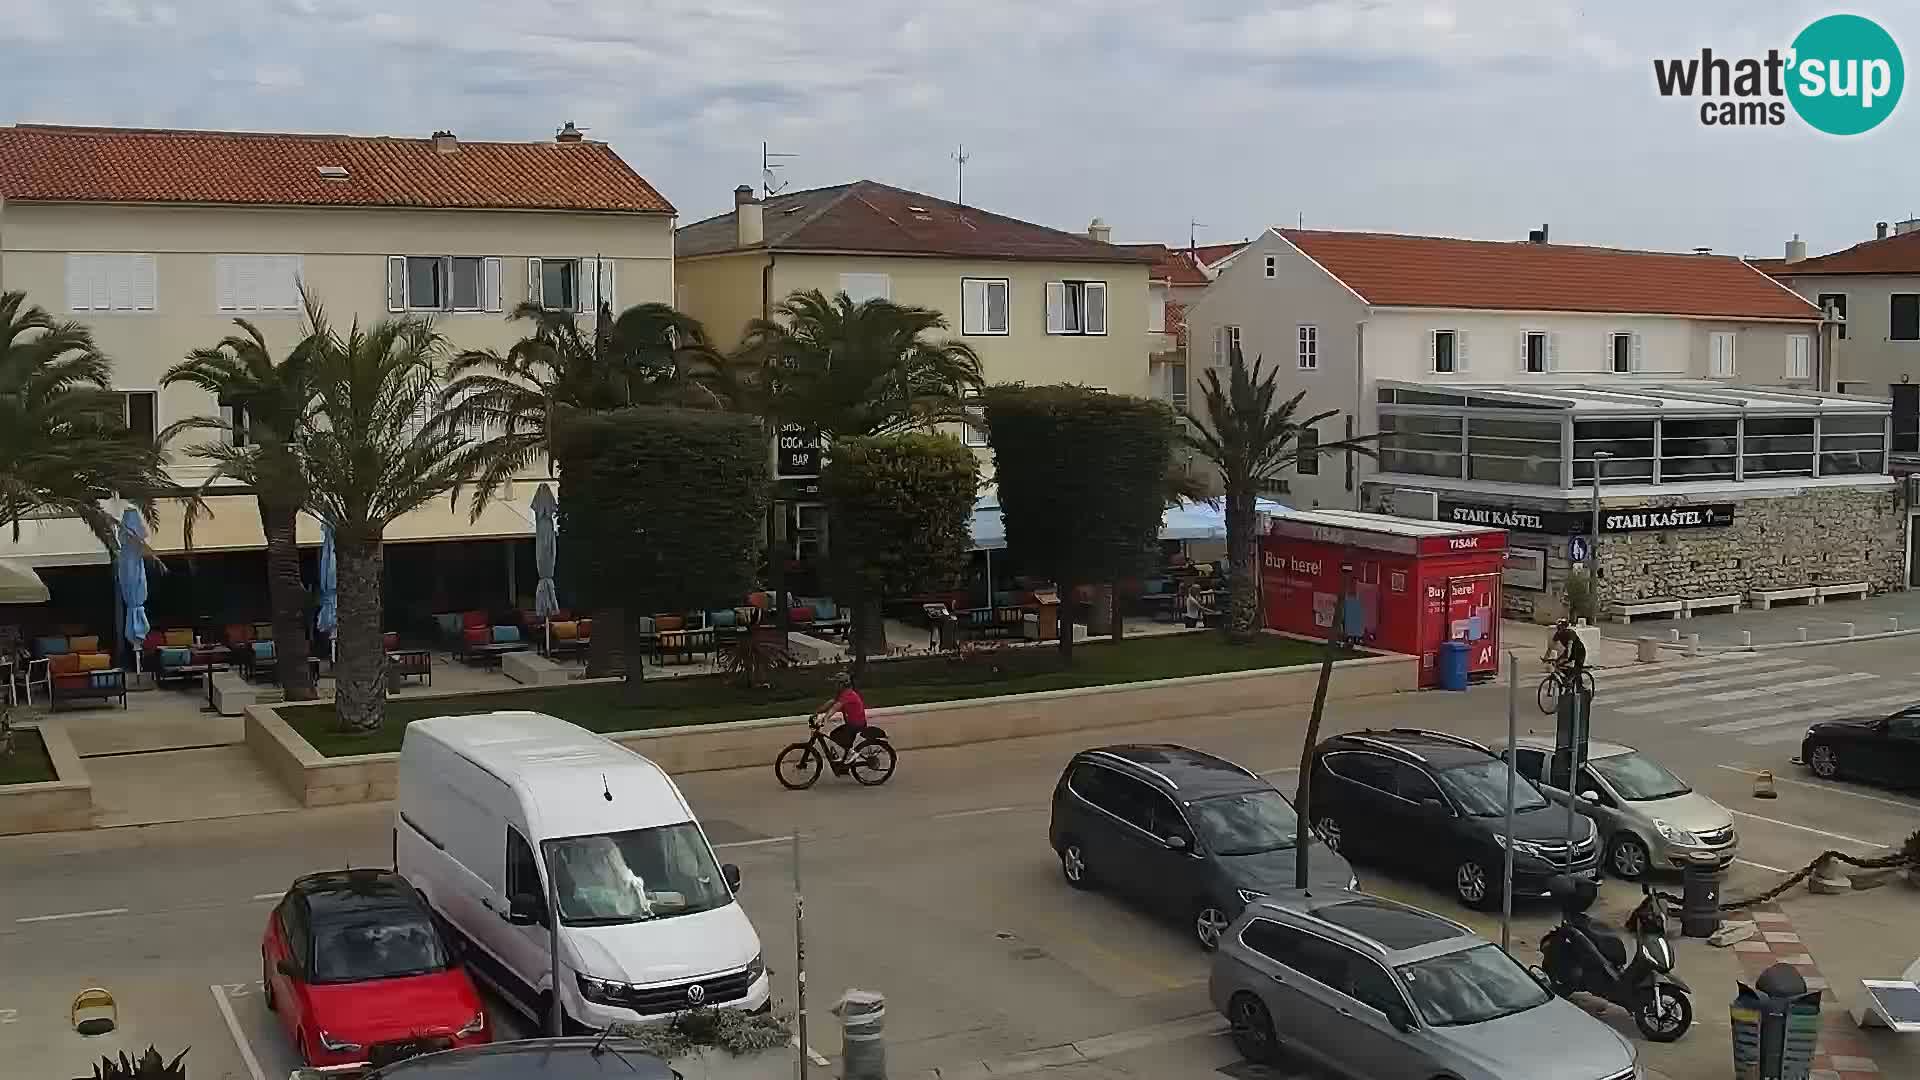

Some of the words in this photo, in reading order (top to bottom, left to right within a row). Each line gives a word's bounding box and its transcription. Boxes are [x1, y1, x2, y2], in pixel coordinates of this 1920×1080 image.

[792, 453, 809, 466] BAR
[1453, 507, 1490, 523] STARI
[1492, 510, 1543, 529] KAŠTEL
[1606, 514, 1648, 529] STARI
[1649, 509, 1702, 527] KAŠTEL
[1449, 537, 1479, 549] TISAK
[1290, 555, 1322, 577] here!
[1428, 586, 1446, 599] Buy
[1451, 583, 1475, 596] here!
